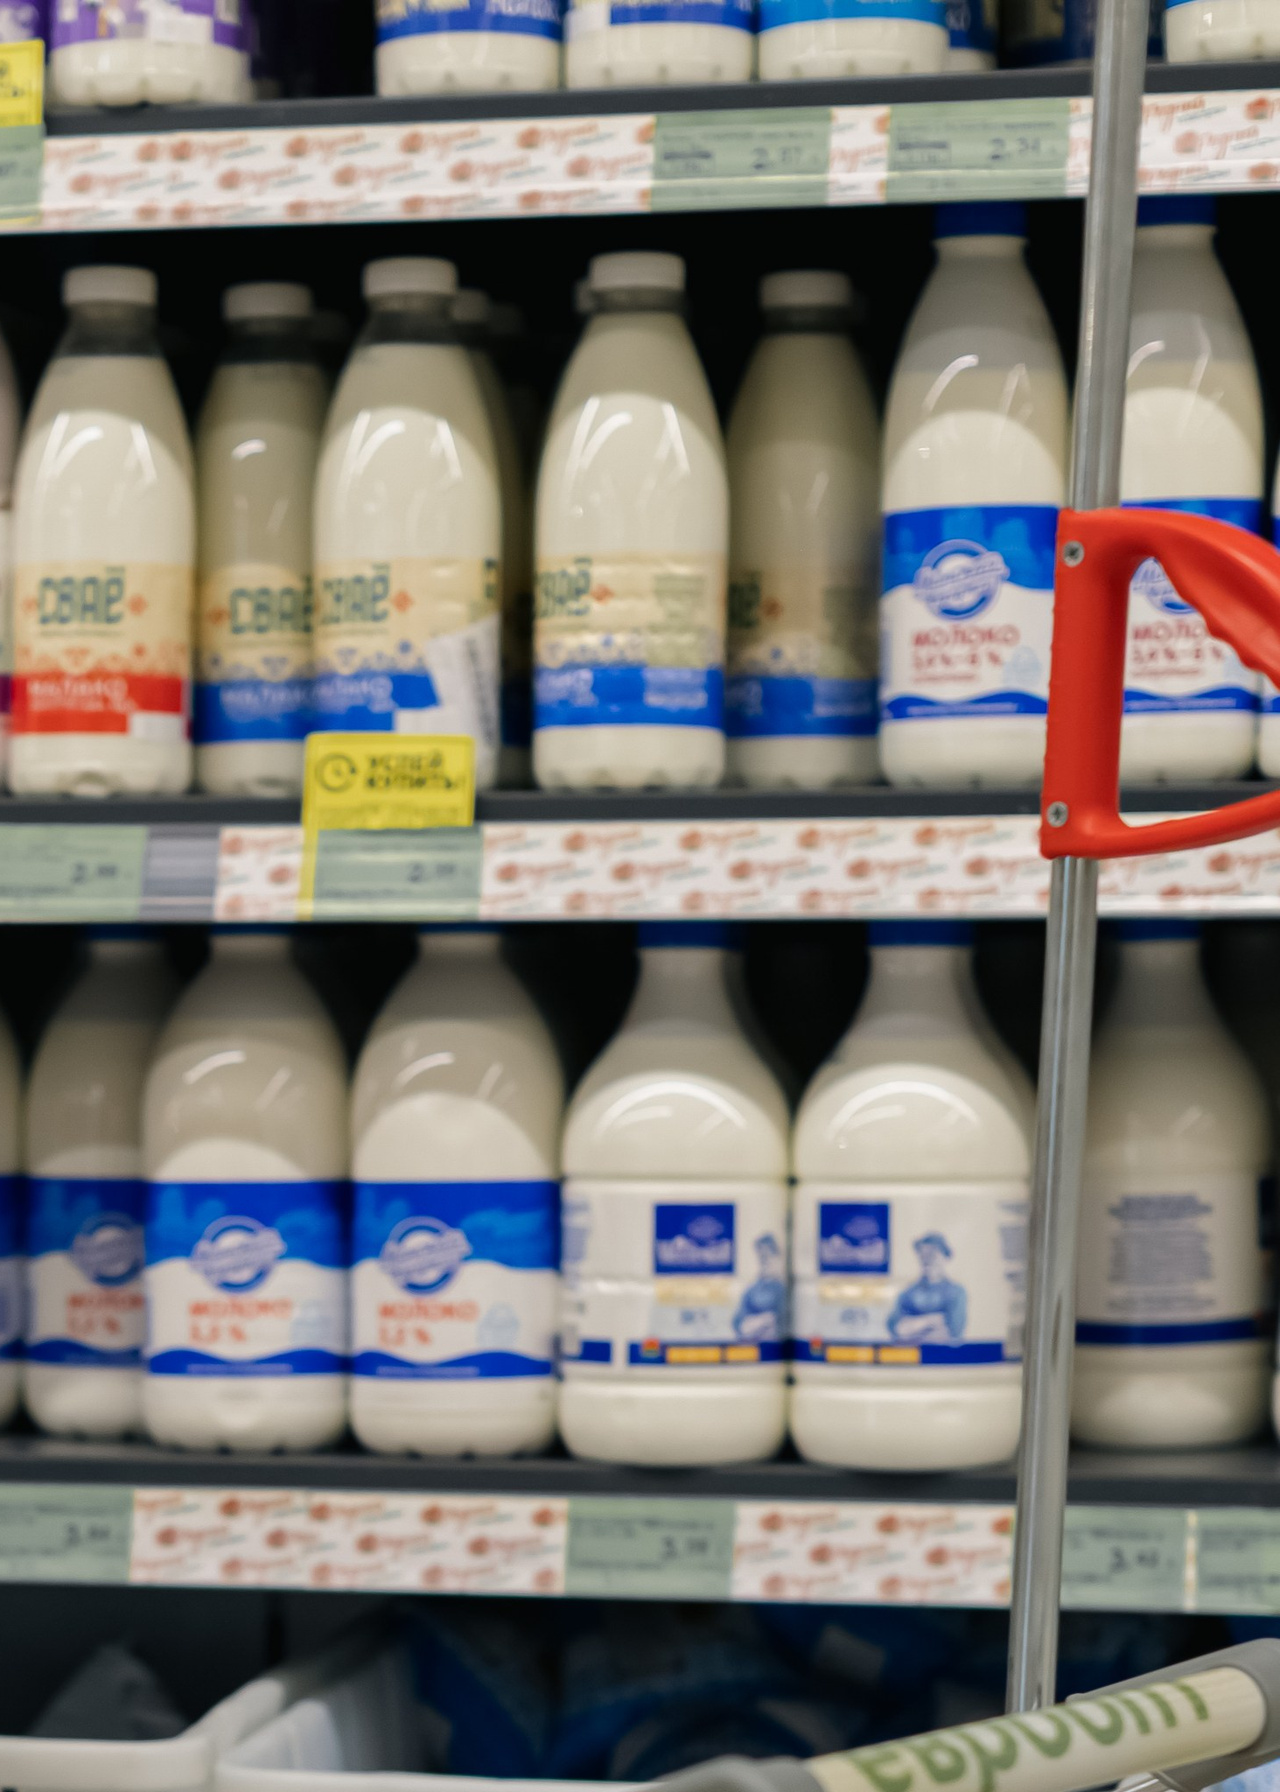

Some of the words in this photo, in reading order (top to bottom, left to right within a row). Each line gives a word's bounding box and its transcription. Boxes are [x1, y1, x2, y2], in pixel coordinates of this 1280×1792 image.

[913, 624, 1022, 647] МОЛОКО
[365, 749, 443, 770] УСПЕЙ
[66, 1291, 144, 1315] МОЛОК
[188, 1296, 294, 1320] МОЛОКО
[377, 1297, 480, 1321] МОЛОКО
